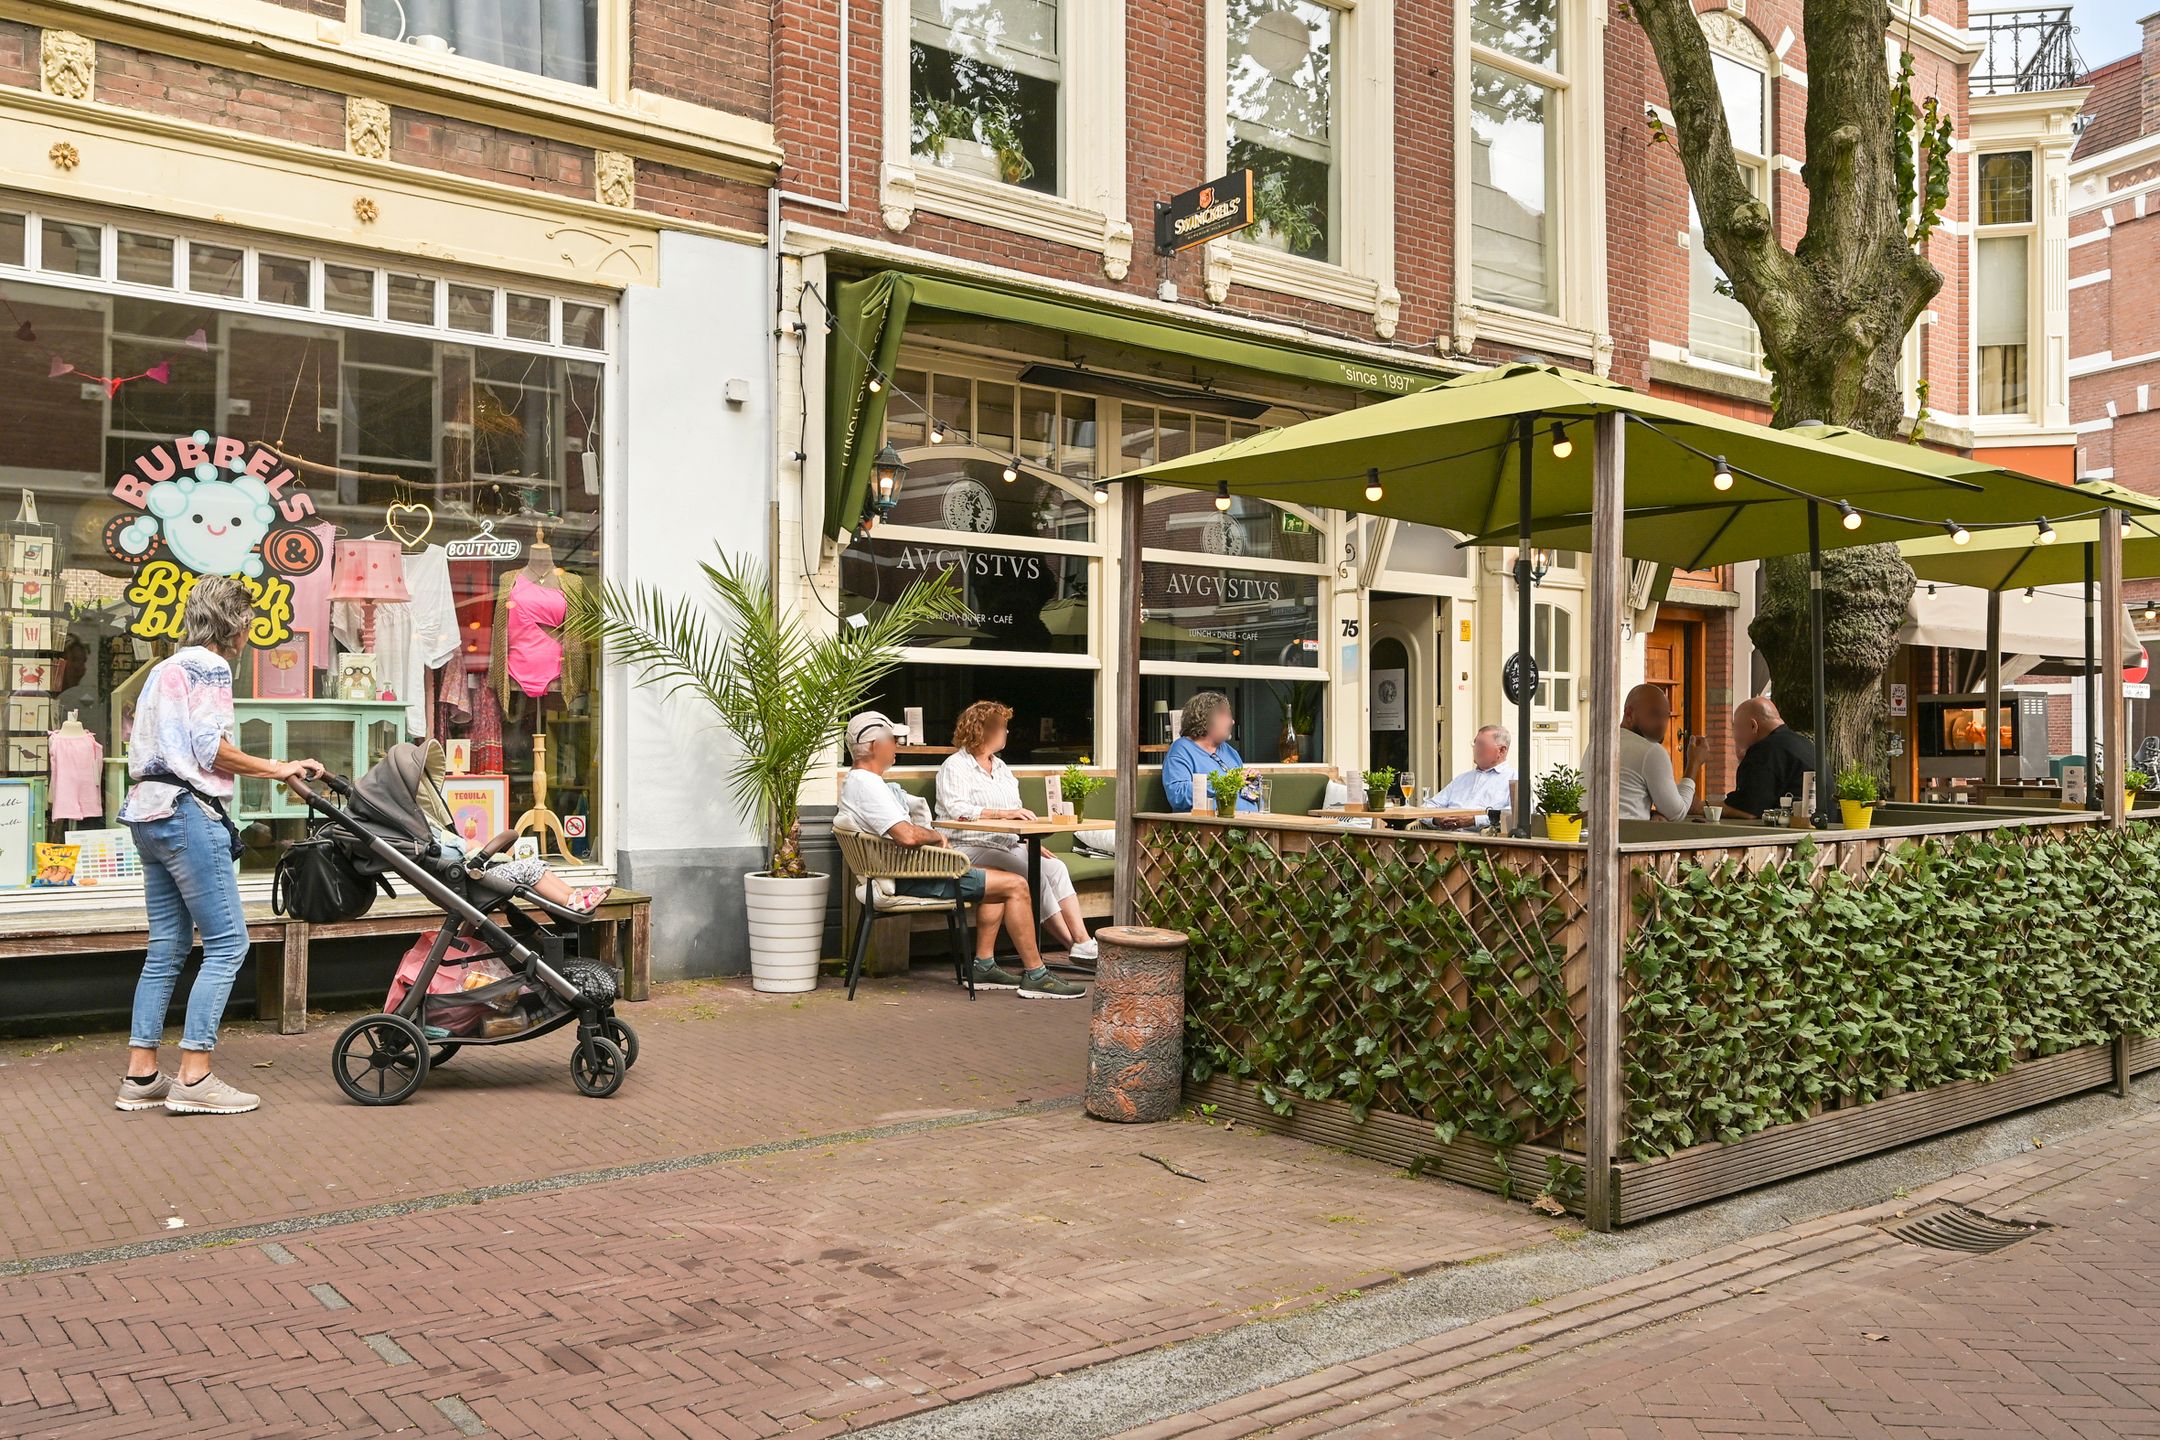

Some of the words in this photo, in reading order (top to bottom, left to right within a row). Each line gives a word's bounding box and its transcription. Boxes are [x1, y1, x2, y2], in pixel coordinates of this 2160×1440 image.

[1340, 364, 1377, 385] "since
[1382, 373, 1415, 391] 1997"
[112, 435, 316, 523] BUBBELS
[284, 538, 308, 564] &
[448, 542, 517, 557] BOUTIQUE
[896, 546, 1040, 580] AVGVSTVS
[1166, 572, 1280, 601] AVGVSTVS
[992, 613, 1013, 625] CAFÉ
[1341, 619, 1359, 637] 75
[1217, 631, 1237, 640] DINER
[1242, 631, 1259, 641] CAFÉ
[454, 792, 487, 800] TEQUILA
